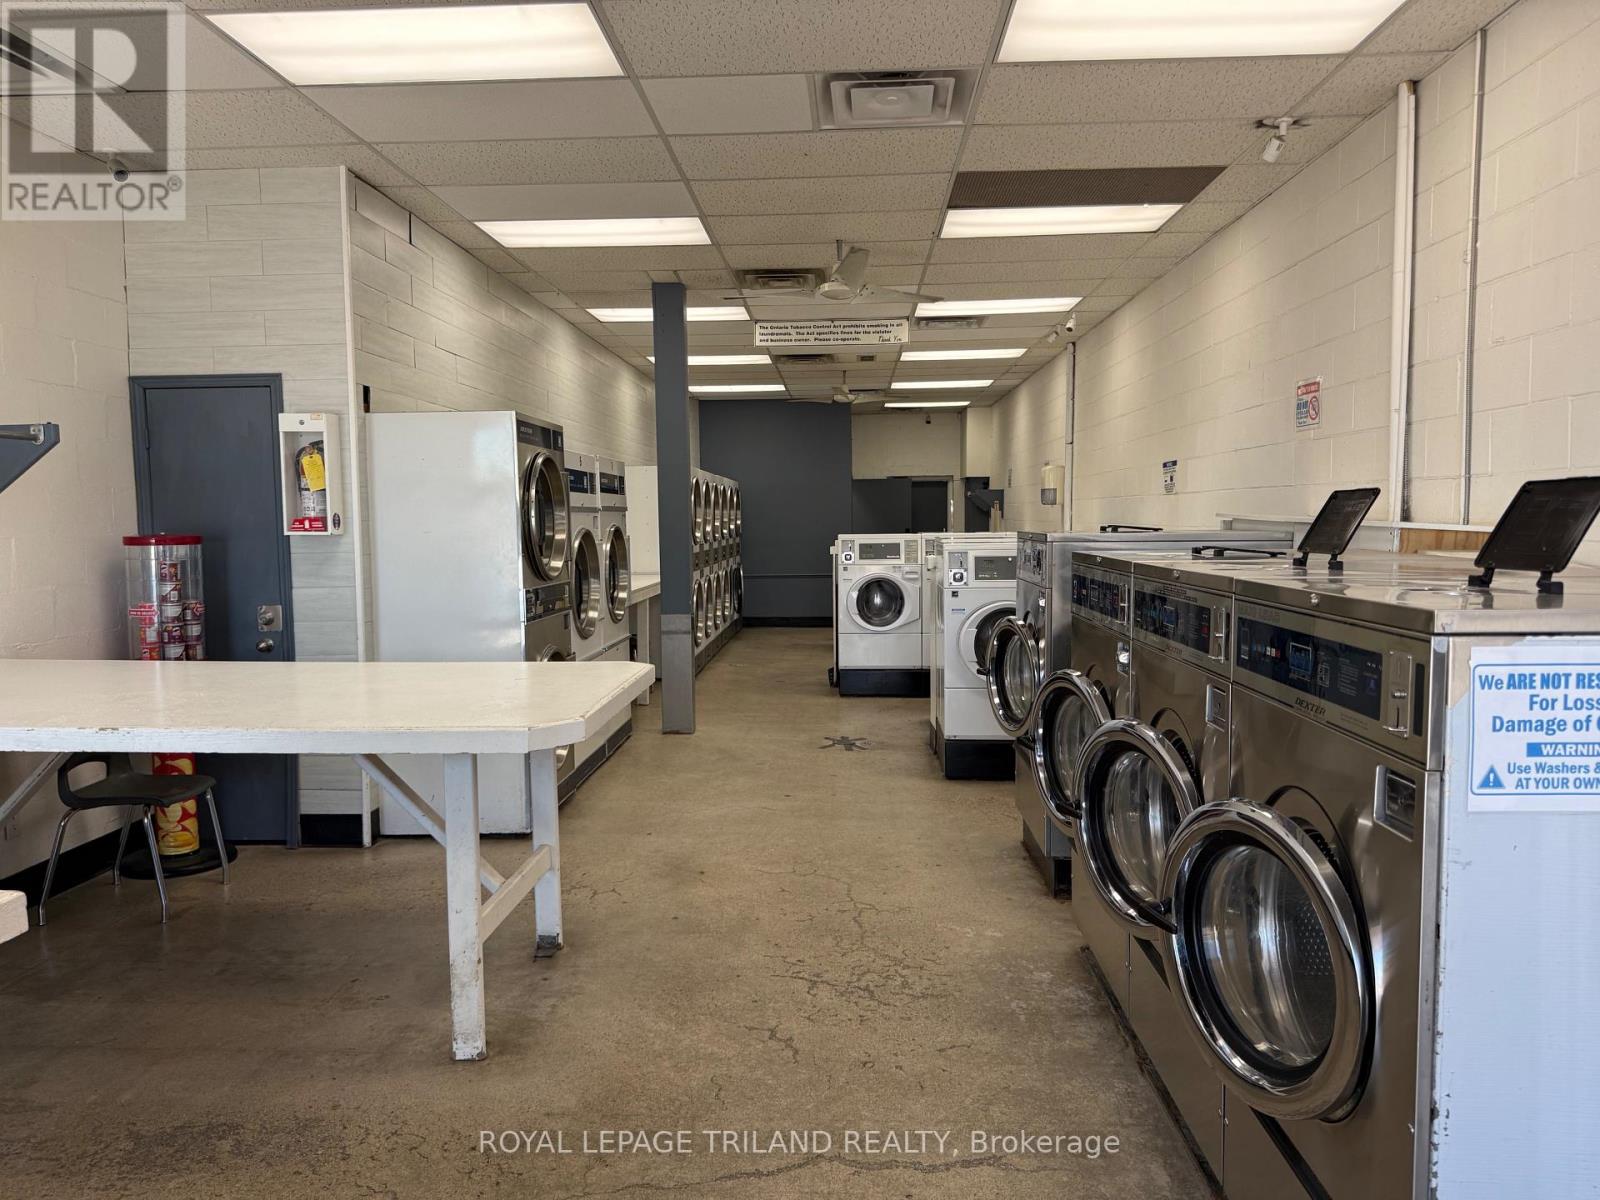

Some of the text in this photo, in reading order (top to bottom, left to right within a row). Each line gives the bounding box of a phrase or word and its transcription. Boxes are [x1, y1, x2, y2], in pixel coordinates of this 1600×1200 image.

[1478, 675, 1504, 690] We
[1506, 673, 1536, 690] ARE
[1540, 673, 1572, 690] NOT
[1295, 697, 1326, 715] DEXTER
[1529, 694, 1558, 711] For
[1491, 715, 1567, 736] Damage
[1573, 714, 1592, 732] of
[1507, 762, 1531, 774] Use
[1534, 762, 1590, 774] Washers
[1515, 777, 1531, 790] AT
[1533, 777, 1570, 790] YOUR
